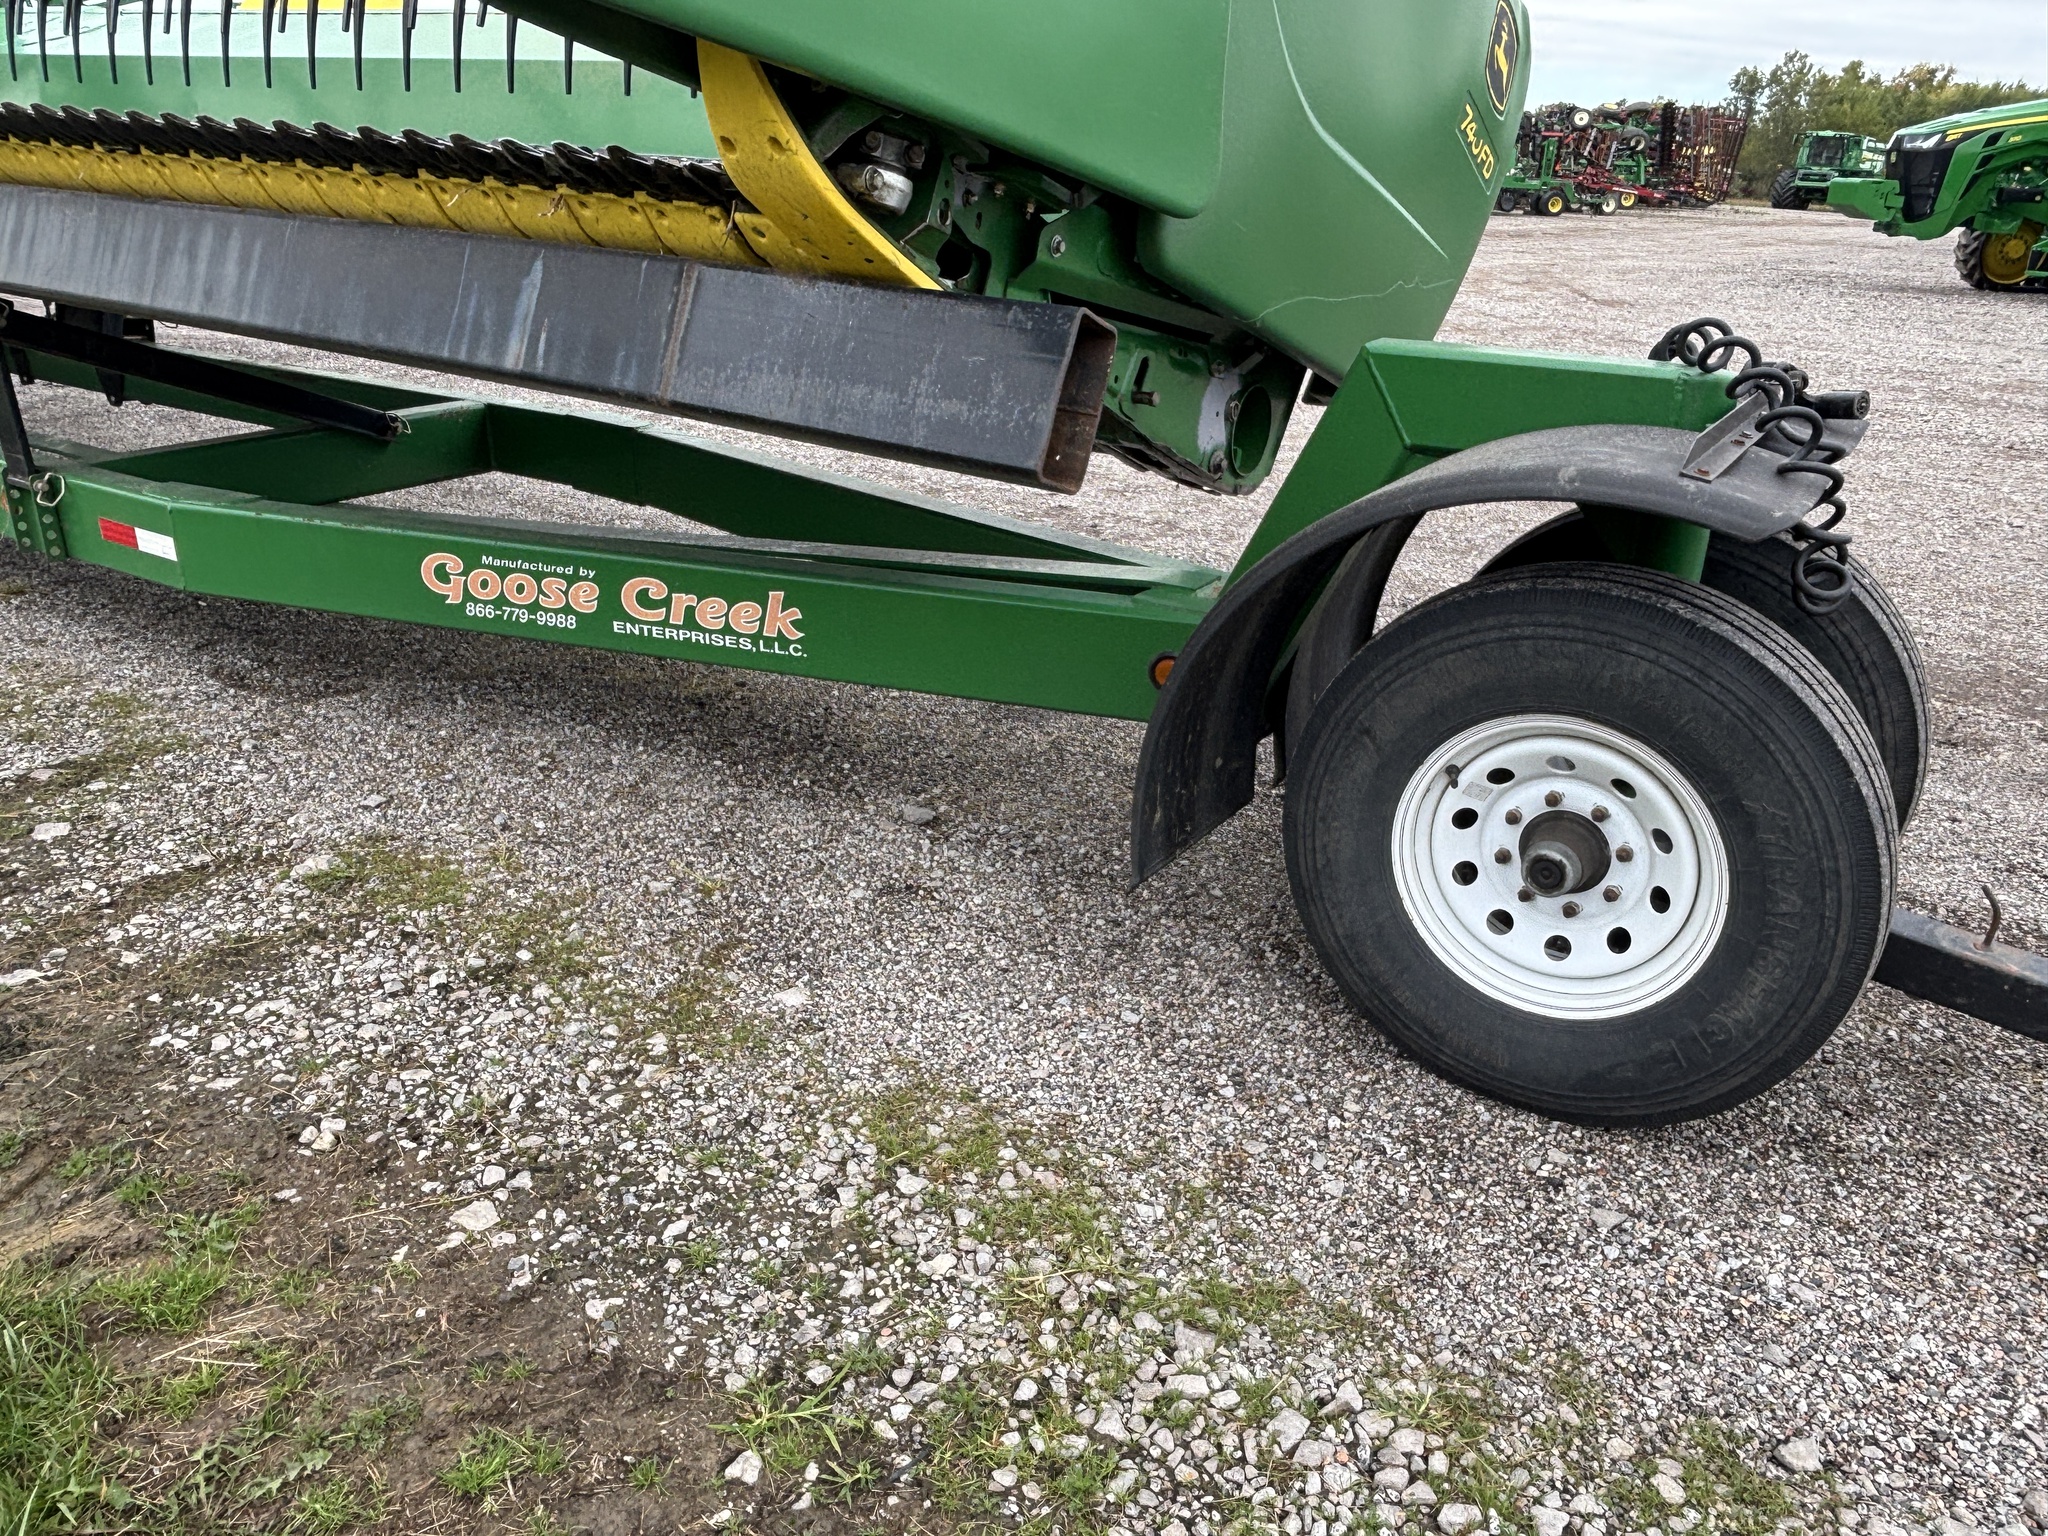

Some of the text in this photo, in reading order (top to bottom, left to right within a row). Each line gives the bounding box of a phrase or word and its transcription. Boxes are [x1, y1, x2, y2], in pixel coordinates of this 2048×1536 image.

[480, 555, 597, 579] Manufactured by
[420, 552, 805, 641] Goose Creek
[465, 602, 577, 630] 866-779-9988
[612, 621, 809, 658] ENTERPRISES, L.L.C.
